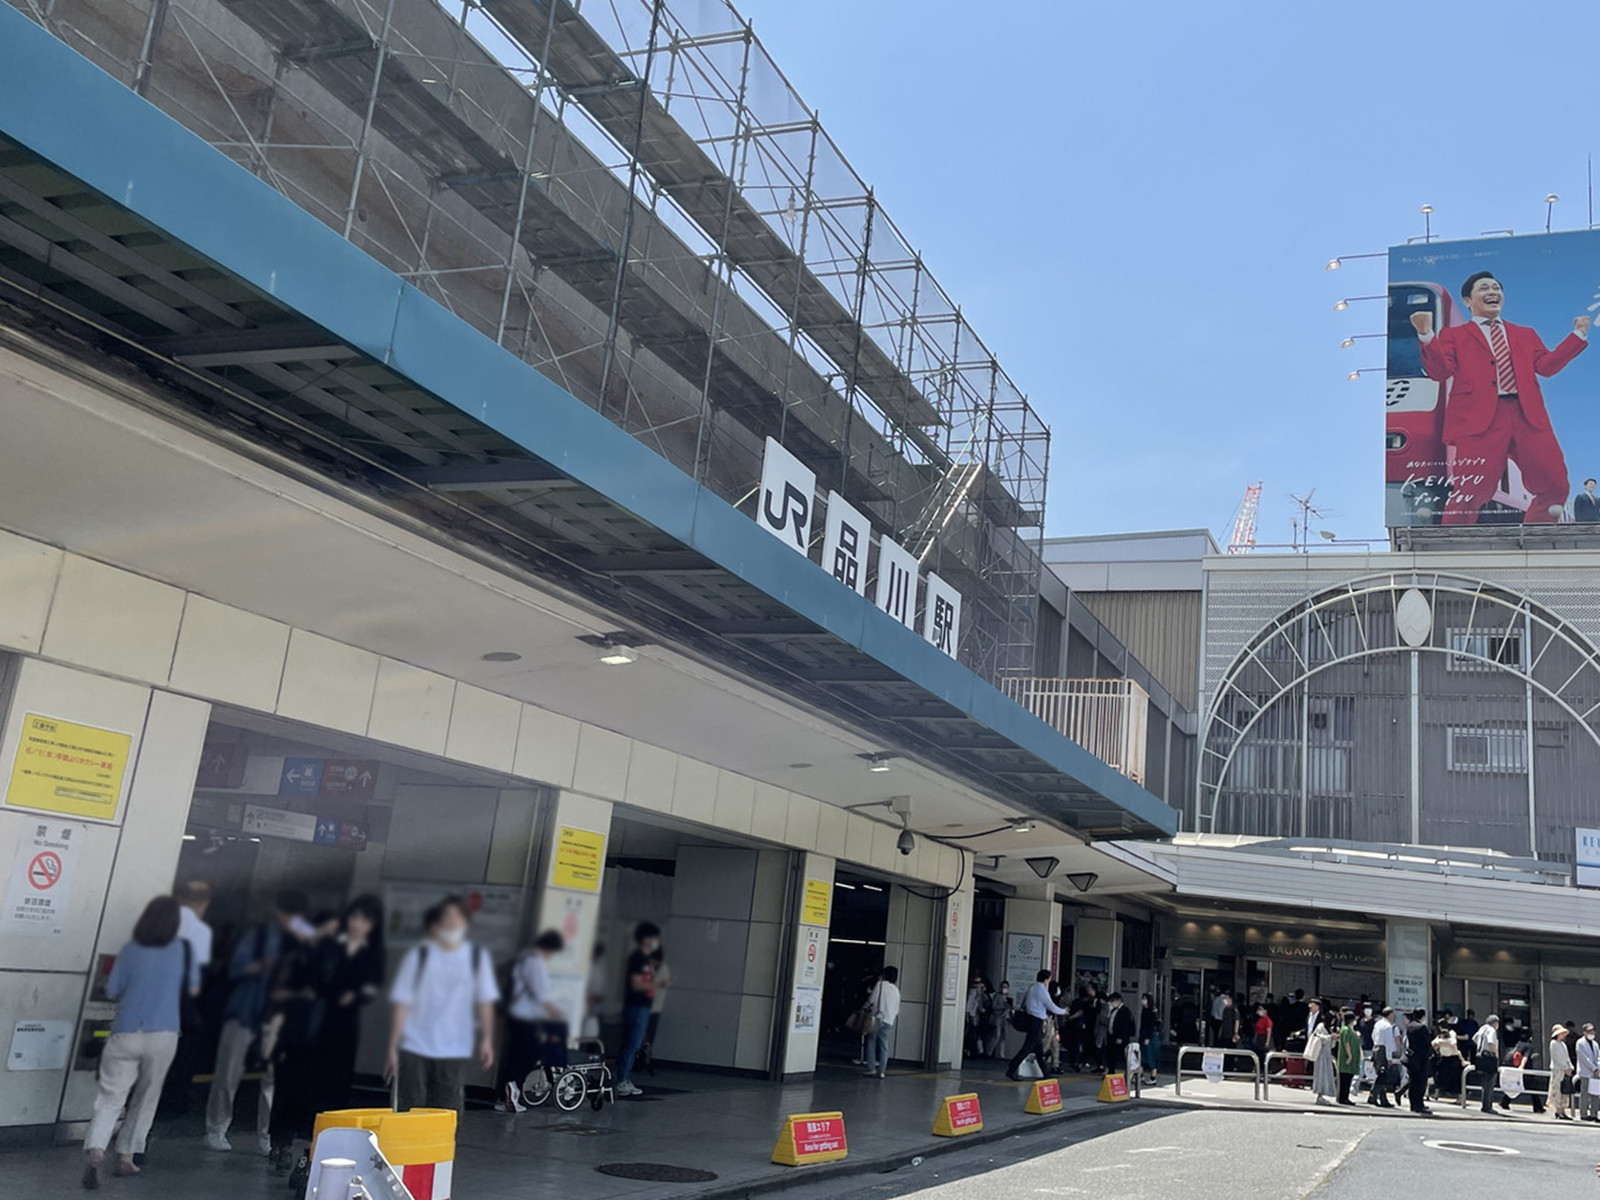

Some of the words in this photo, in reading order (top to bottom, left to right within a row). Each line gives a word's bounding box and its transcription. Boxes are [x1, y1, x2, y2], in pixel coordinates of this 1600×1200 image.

[1400, 473, 1485, 495] KEIKYU
[1414, 492, 1441, 506] for
[1445, 489, 1474, 506] You
[765, 481, 808, 548] JR
